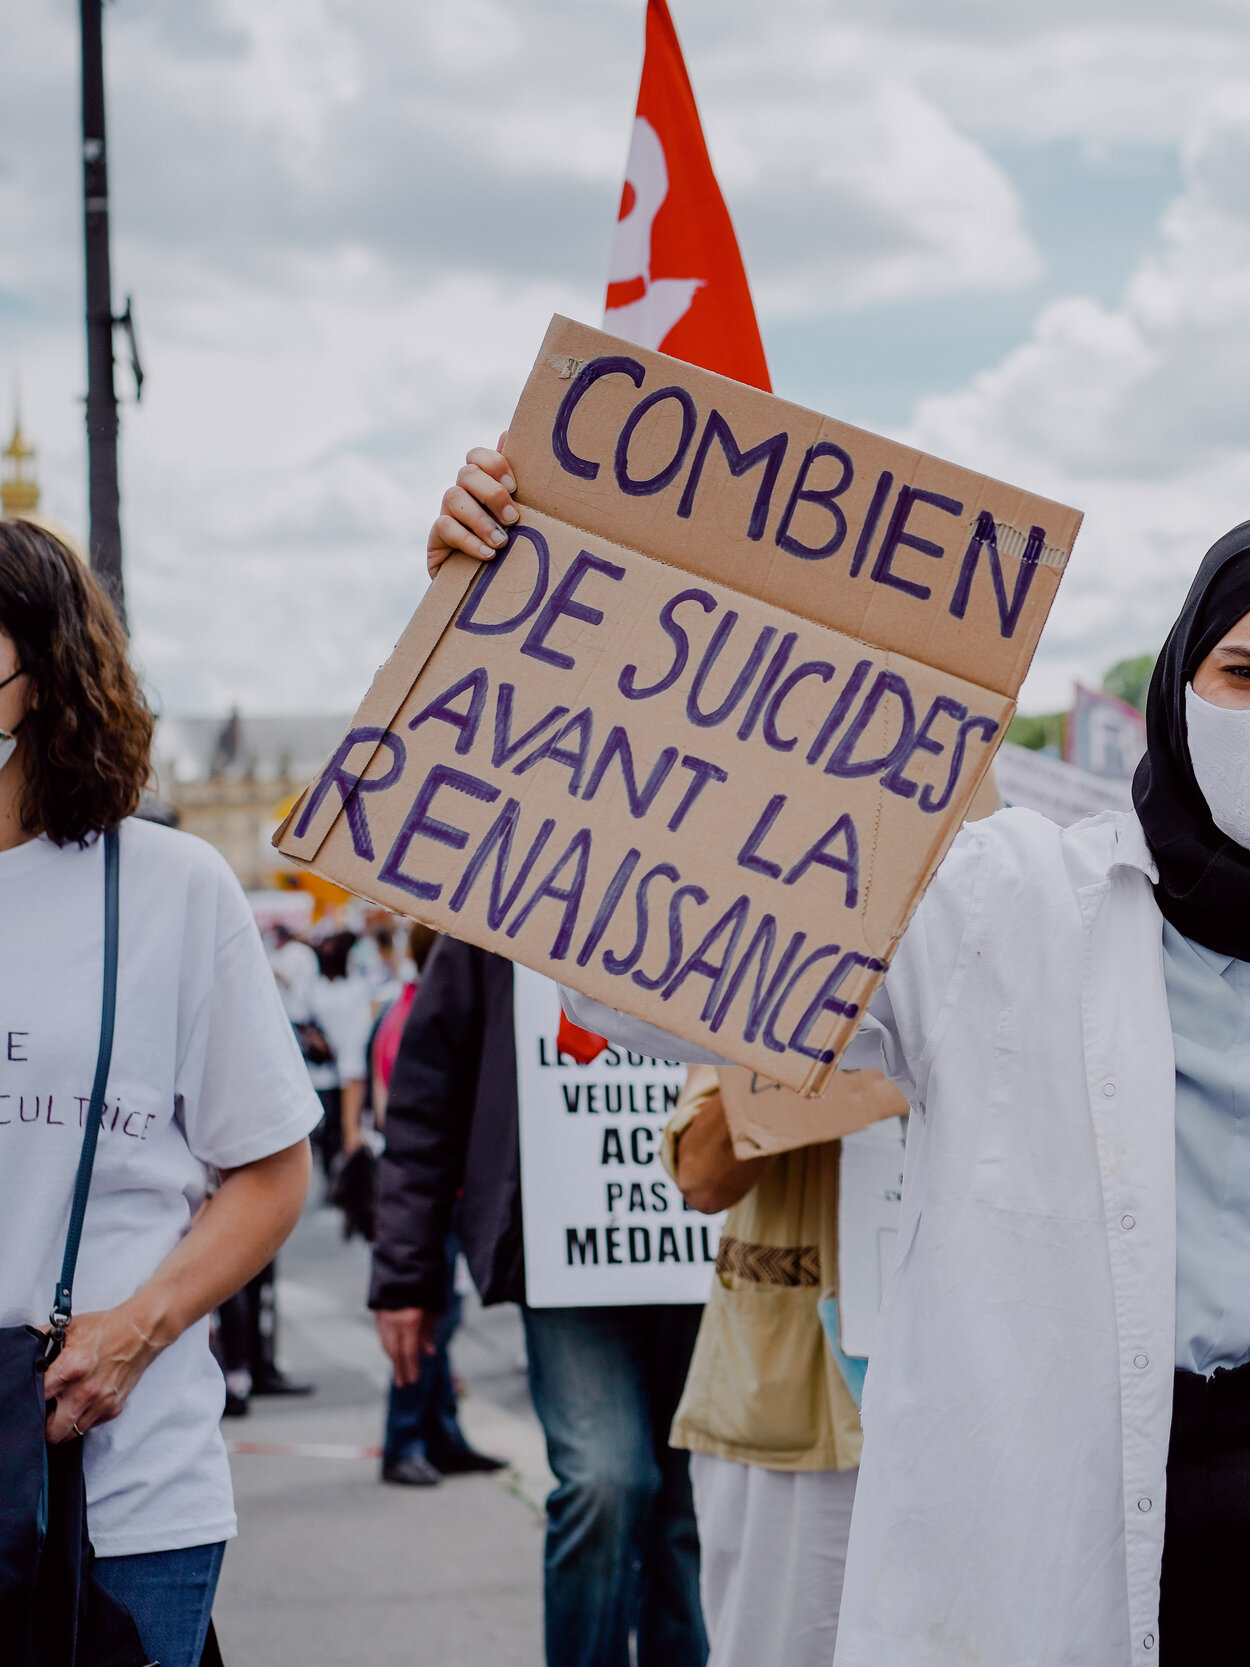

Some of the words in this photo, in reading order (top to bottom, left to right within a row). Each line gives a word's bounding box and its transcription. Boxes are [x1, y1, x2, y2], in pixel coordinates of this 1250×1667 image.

[552, 356, 1049, 639] COMBIEN
[409, 667, 728, 833] AVANT
[738, 793, 859, 910] LA
[454, 524, 626, 671] DE
[617, 587, 998, 814] SUICIDES
[294, 726, 889, 1064] RENAISSANCE
[601, 1127, 663, 1165] AC
[607, 1182, 668, 1212] PAS
